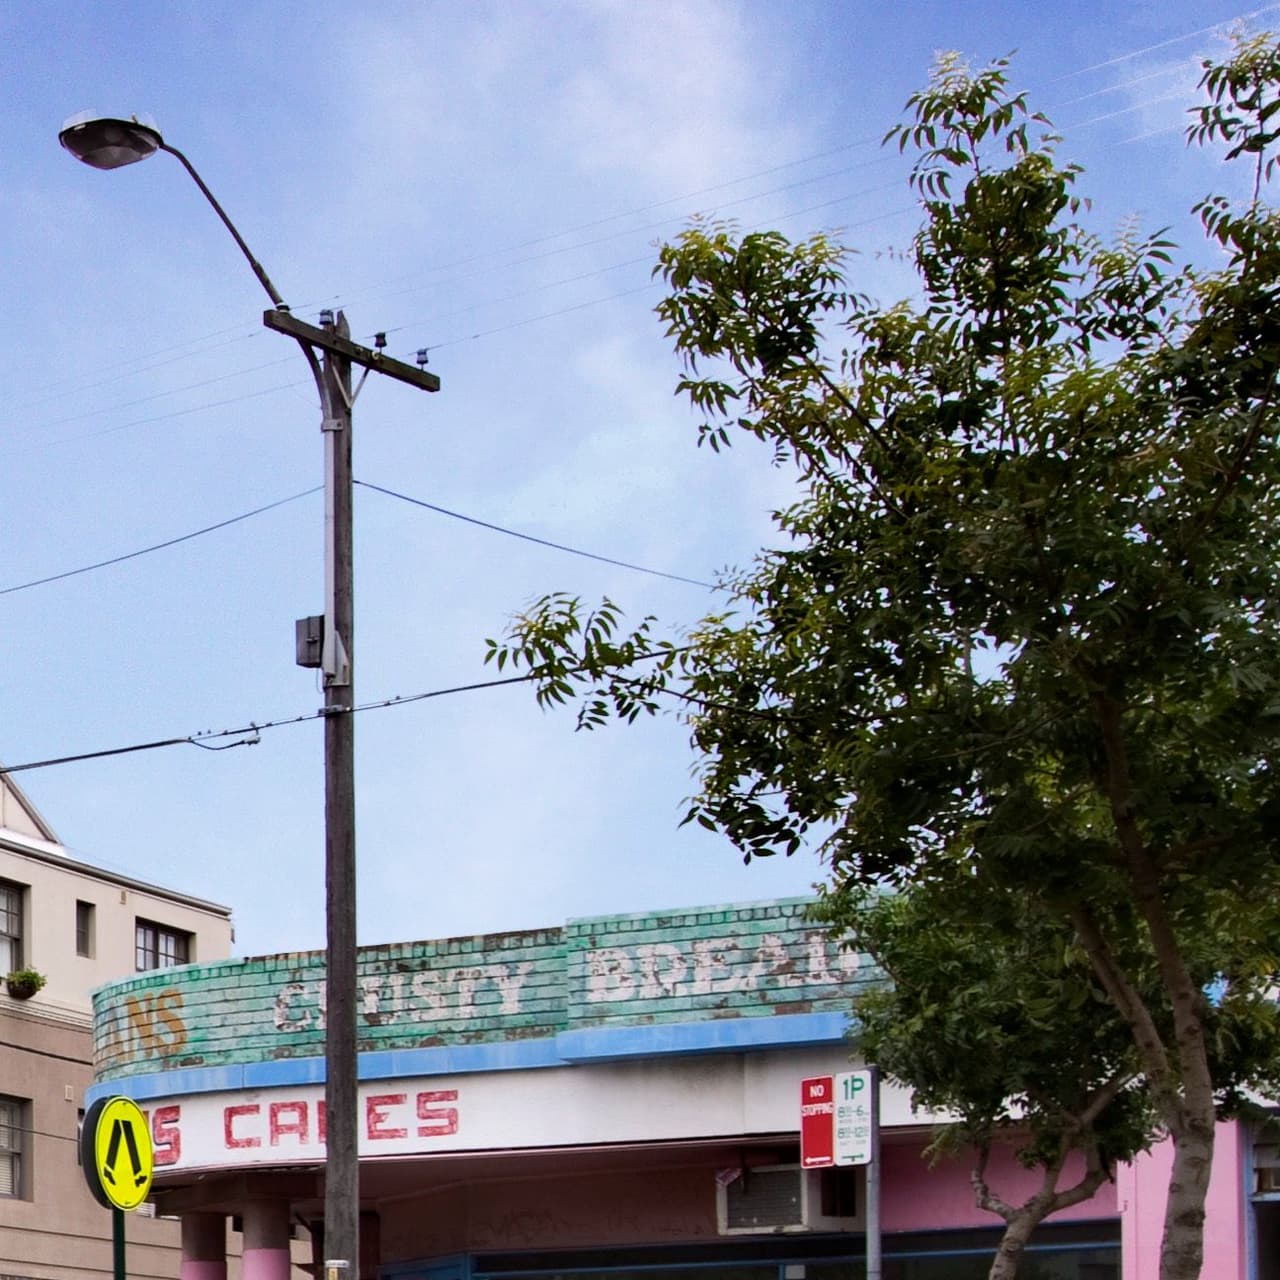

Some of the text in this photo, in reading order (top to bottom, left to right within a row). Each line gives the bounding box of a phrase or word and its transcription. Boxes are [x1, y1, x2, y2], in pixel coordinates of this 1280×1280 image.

[273, 962, 535, 1032] CUSTY
[809, 1084, 825, 1098] NO
[843, 1075, 865, 1100] 1P
[223, 1090, 458, 1150] CAES
[801, 1102, 833, 1117] STOPPING
